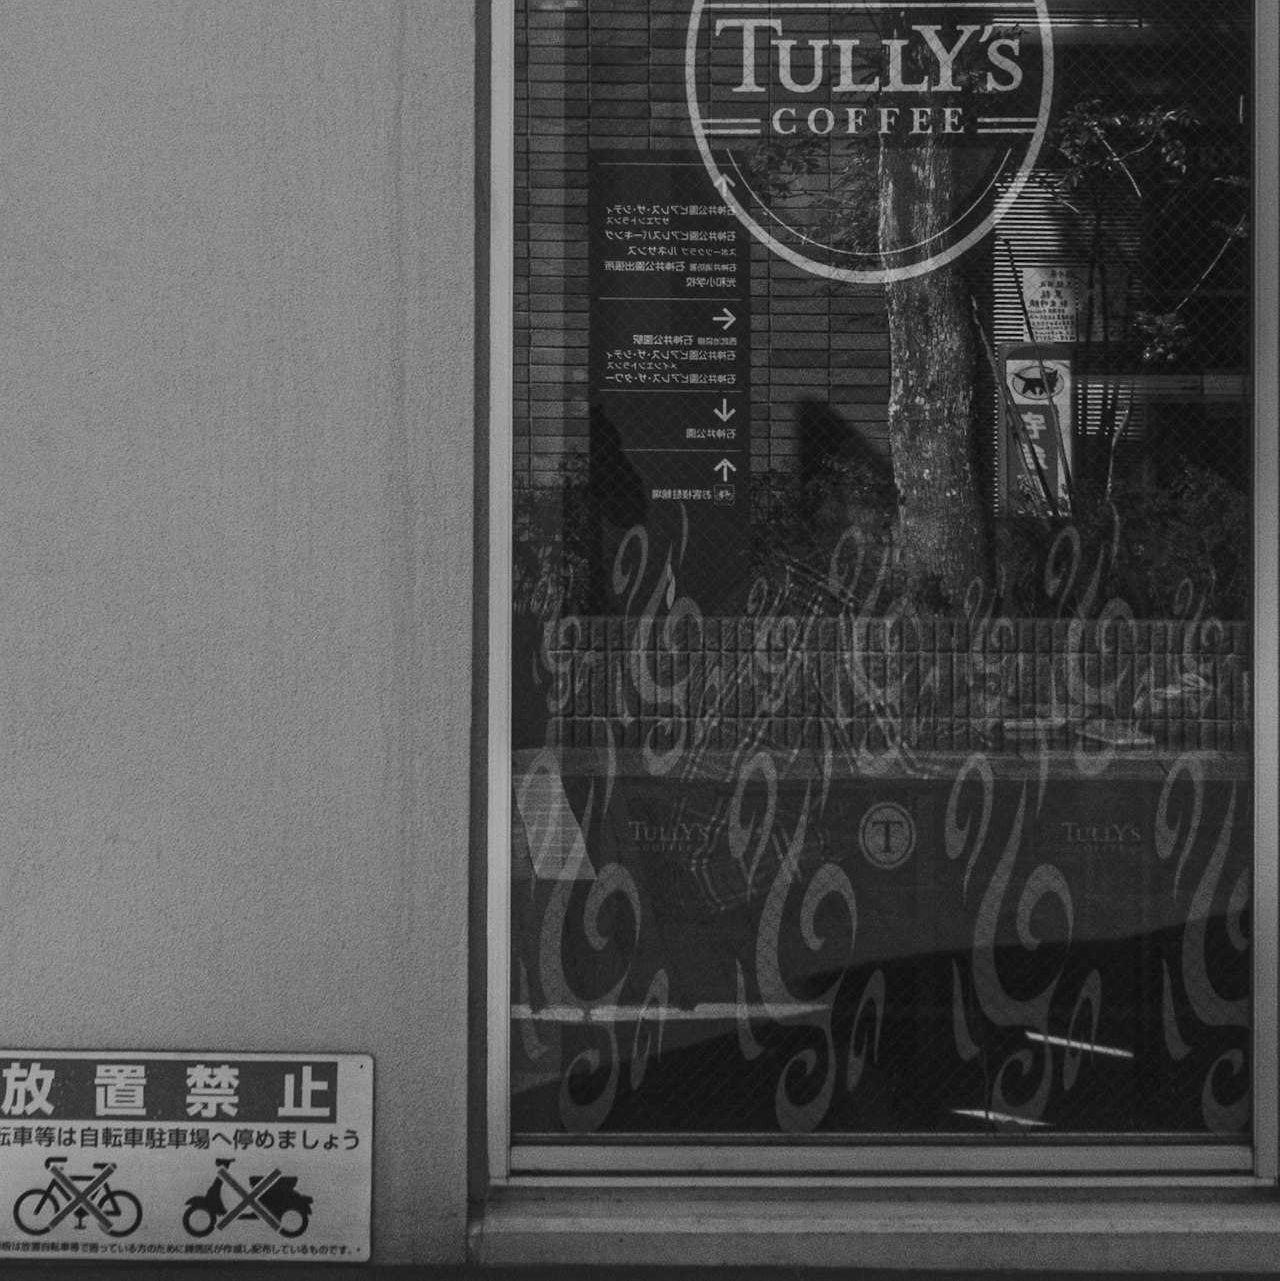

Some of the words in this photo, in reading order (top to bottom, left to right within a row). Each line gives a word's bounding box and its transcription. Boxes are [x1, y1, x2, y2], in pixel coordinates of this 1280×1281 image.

[715, 18, 1023, 94] TULLY'S
[772, 106, 966, 136] COFFEE
[1, 1062, 331, 1119] 放置禁止
